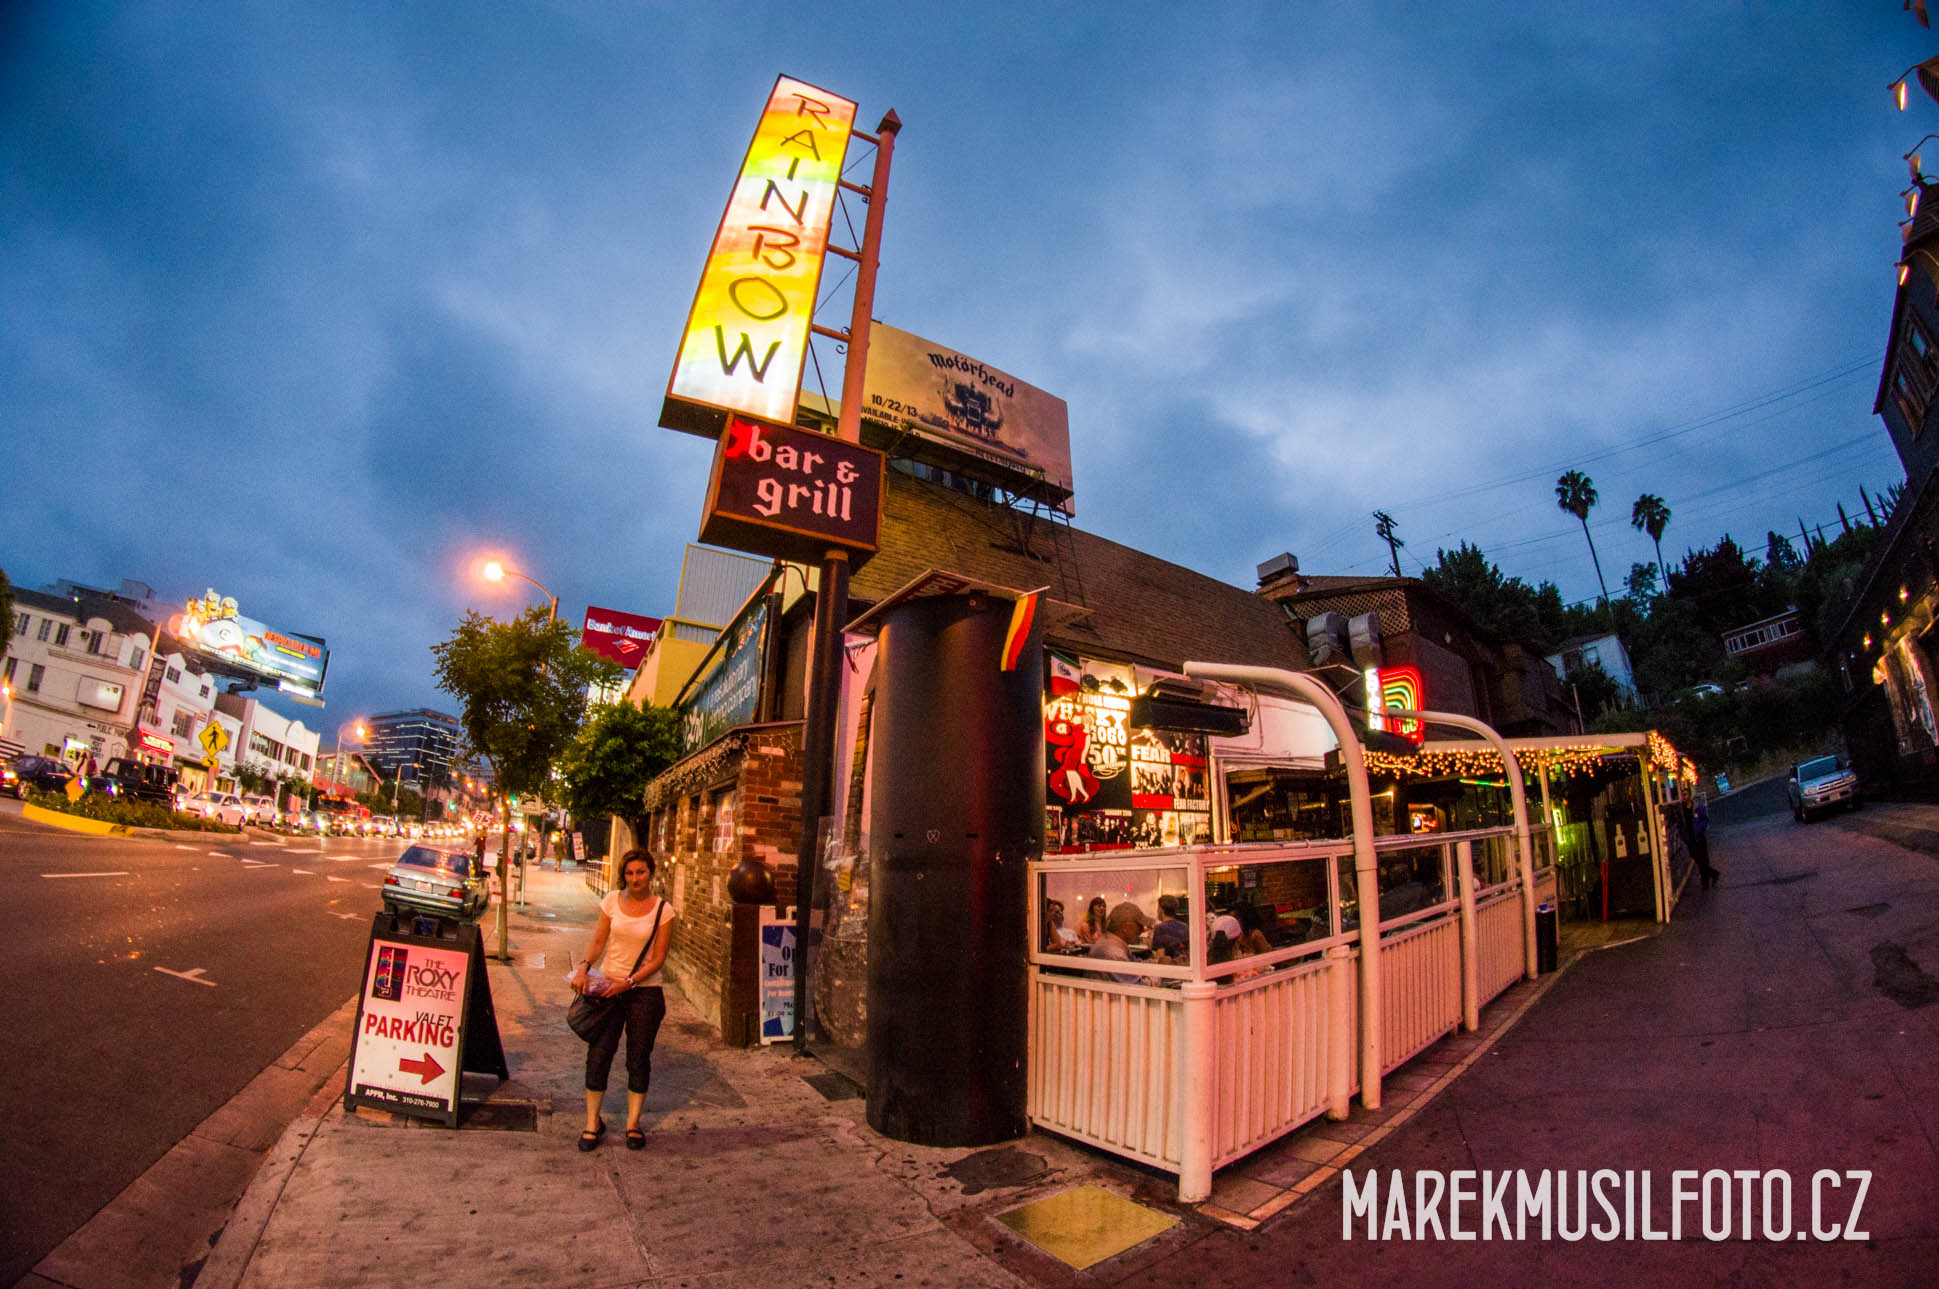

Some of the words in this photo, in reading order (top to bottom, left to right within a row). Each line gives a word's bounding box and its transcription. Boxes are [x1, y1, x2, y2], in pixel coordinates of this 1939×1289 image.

[714, 92, 831, 386] RAINBOW
[927, 352, 1016, 399] Motörhead
[871, 393, 918, 417] 10/22/13
[747, 425, 824, 475] bar
[836, 460, 860, 484] &
[752, 477, 852, 523] grill
[586, 618, 613, 634] Bank
[424, 958, 446, 972] THE
[768, 962, 789, 976] For
[406, 965, 461, 990] ROXY
[405, 985, 457, 1002] THEATRE
[364, 1013, 455, 1048] PARKING
[415, 1010, 454, 1027] VALET
